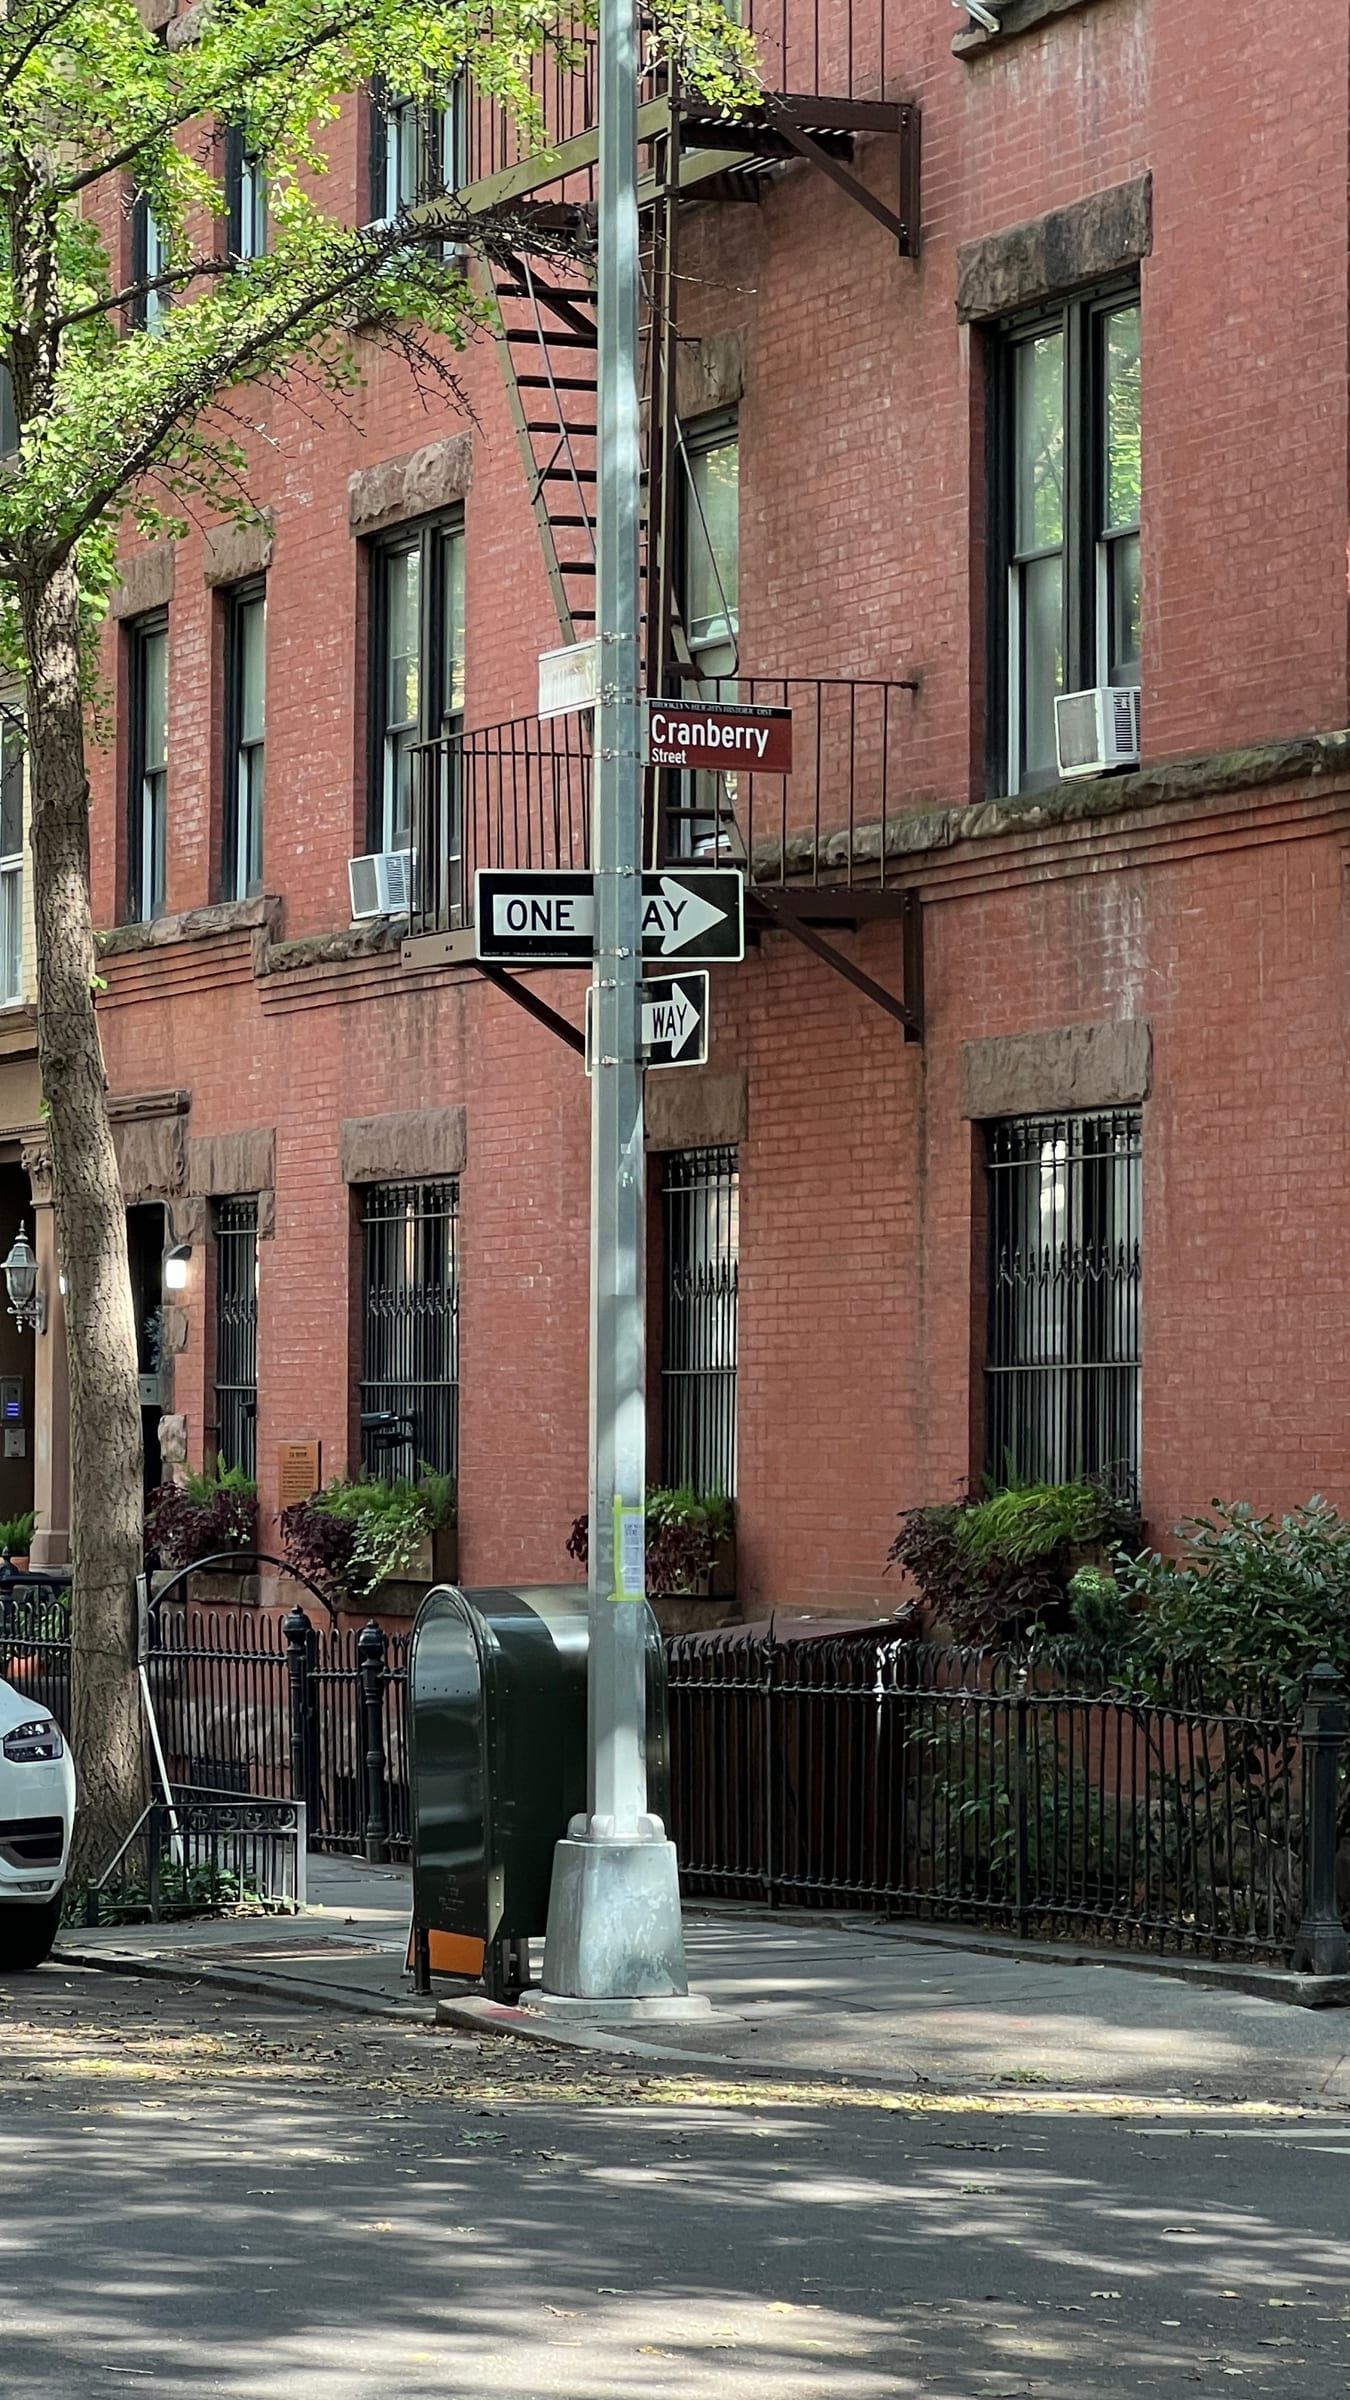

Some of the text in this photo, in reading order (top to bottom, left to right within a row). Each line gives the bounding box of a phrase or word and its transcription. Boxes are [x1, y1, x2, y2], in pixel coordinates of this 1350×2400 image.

[652, 701, 690, 710] BROOKLYN
[691, 703, 722, 712] HEIGHTS
[652, 714, 769, 758] Cranberry
[652, 748, 687, 764] Street
[507, 899, 688, 932] ONE AY
[653, 1003, 688, 1039] WAY
